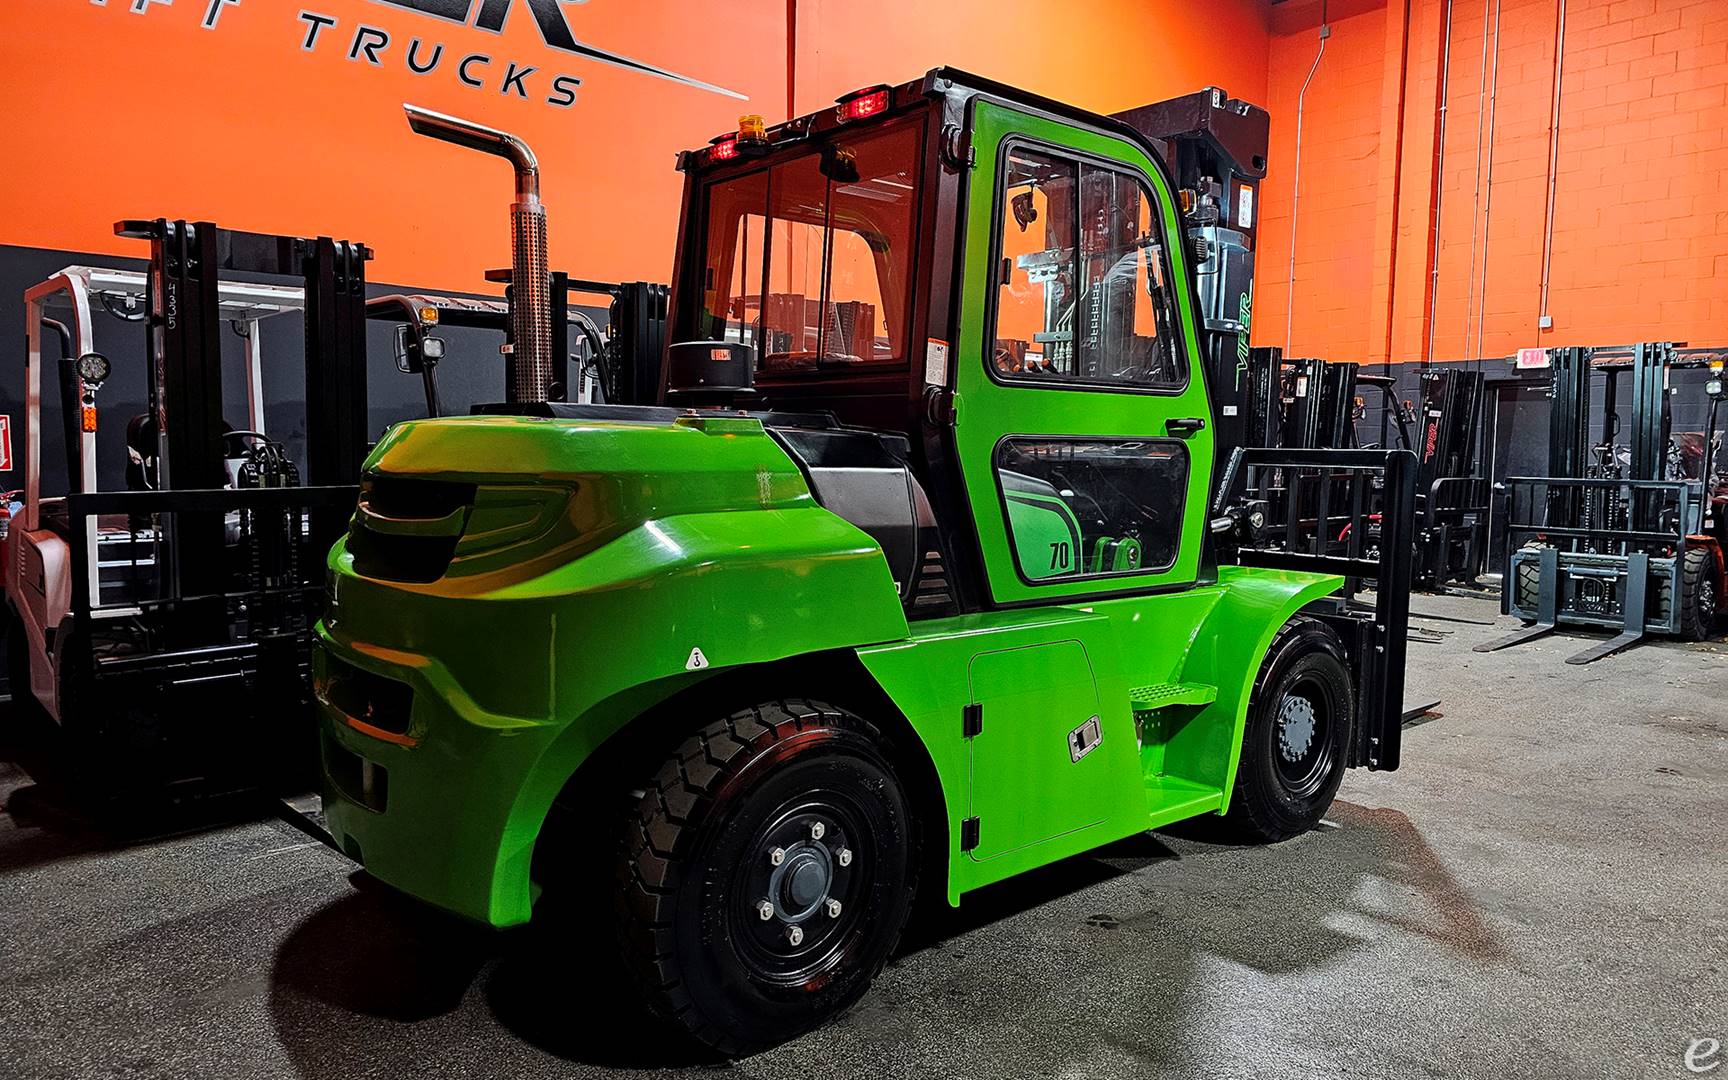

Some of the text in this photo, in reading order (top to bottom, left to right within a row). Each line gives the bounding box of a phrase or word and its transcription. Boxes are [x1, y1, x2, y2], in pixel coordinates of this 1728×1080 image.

[298, 10, 583, 108] TRUCKS
[1235, 279, 1253, 391] VIPER
[1049, 541, 1069, 570] 70
